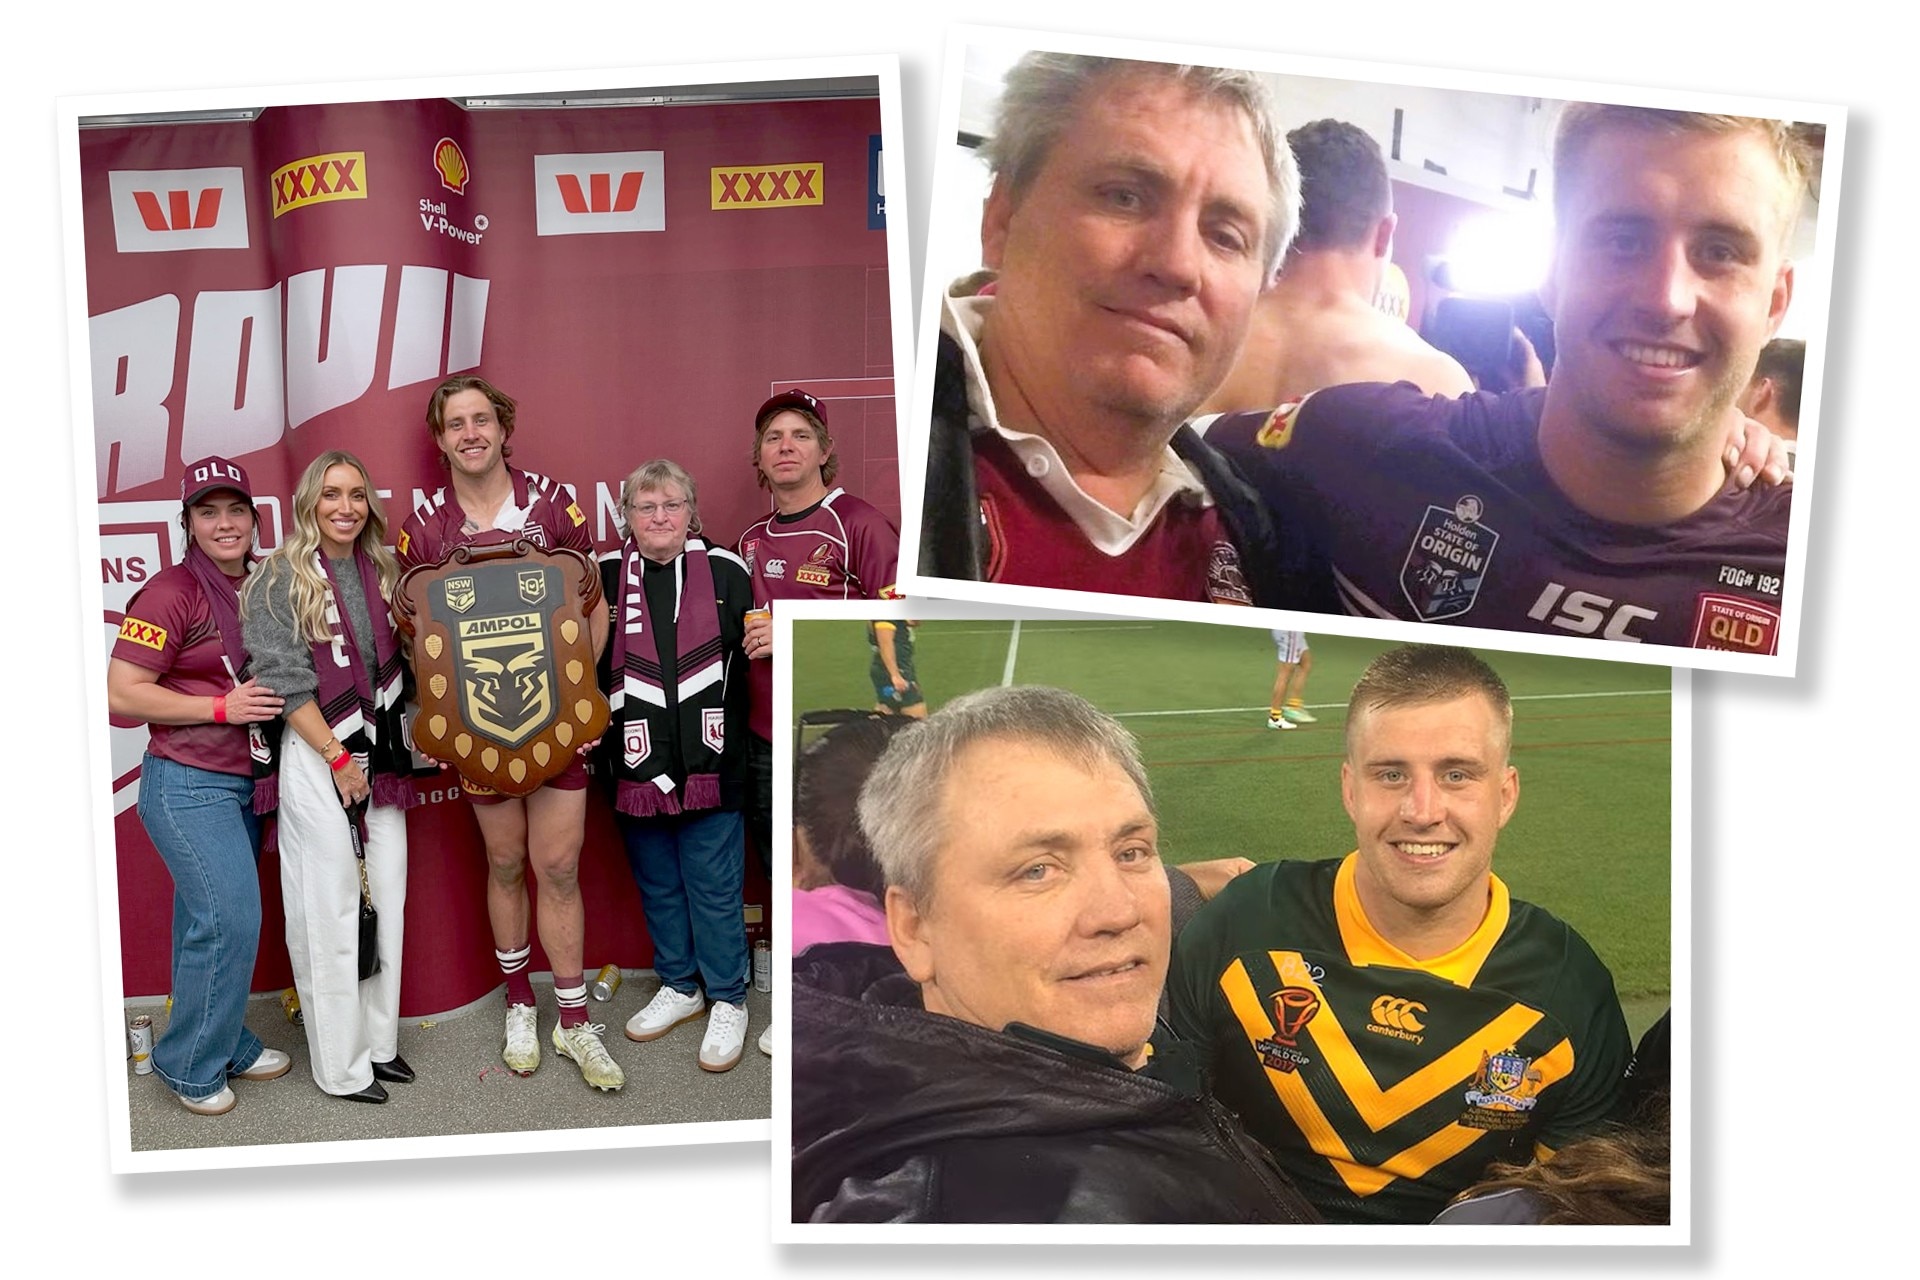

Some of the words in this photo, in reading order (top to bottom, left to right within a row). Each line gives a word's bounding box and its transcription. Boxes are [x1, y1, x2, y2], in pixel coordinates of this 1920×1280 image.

[273, 159, 359, 211] XXXX
[718, 169, 817, 203] XXXX
[419, 198, 447, 215] Shell
[420, 213, 483, 245] V-Power
[194, 462, 242, 482] QLD
[1433, 527, 1465, 546] STATE
[1464, 540, 1480, 552] OF
[1443, 518, 1477, 540] Holden
[1421, 535, 1483, 571] ORIGIN
[447, 579, 471, 590] NSW
[1718, 565, 1754, 587] FOG#
[1757, 574, 1781, 595] 192
[1527, 582, 1658, 644] ISC
[1712, 605, 1735, 617] STATE
[1735, 610, 1746, 619] OF
[466, 616, 536, 634] AMPOL
[1710, 615, 1764, 647] QLD
[1366, 1022, 1425, 1046] canterbury
[1265, 1055, 1297, 1073] 2017
[1290, 1053, 1310, 1065] CUP
